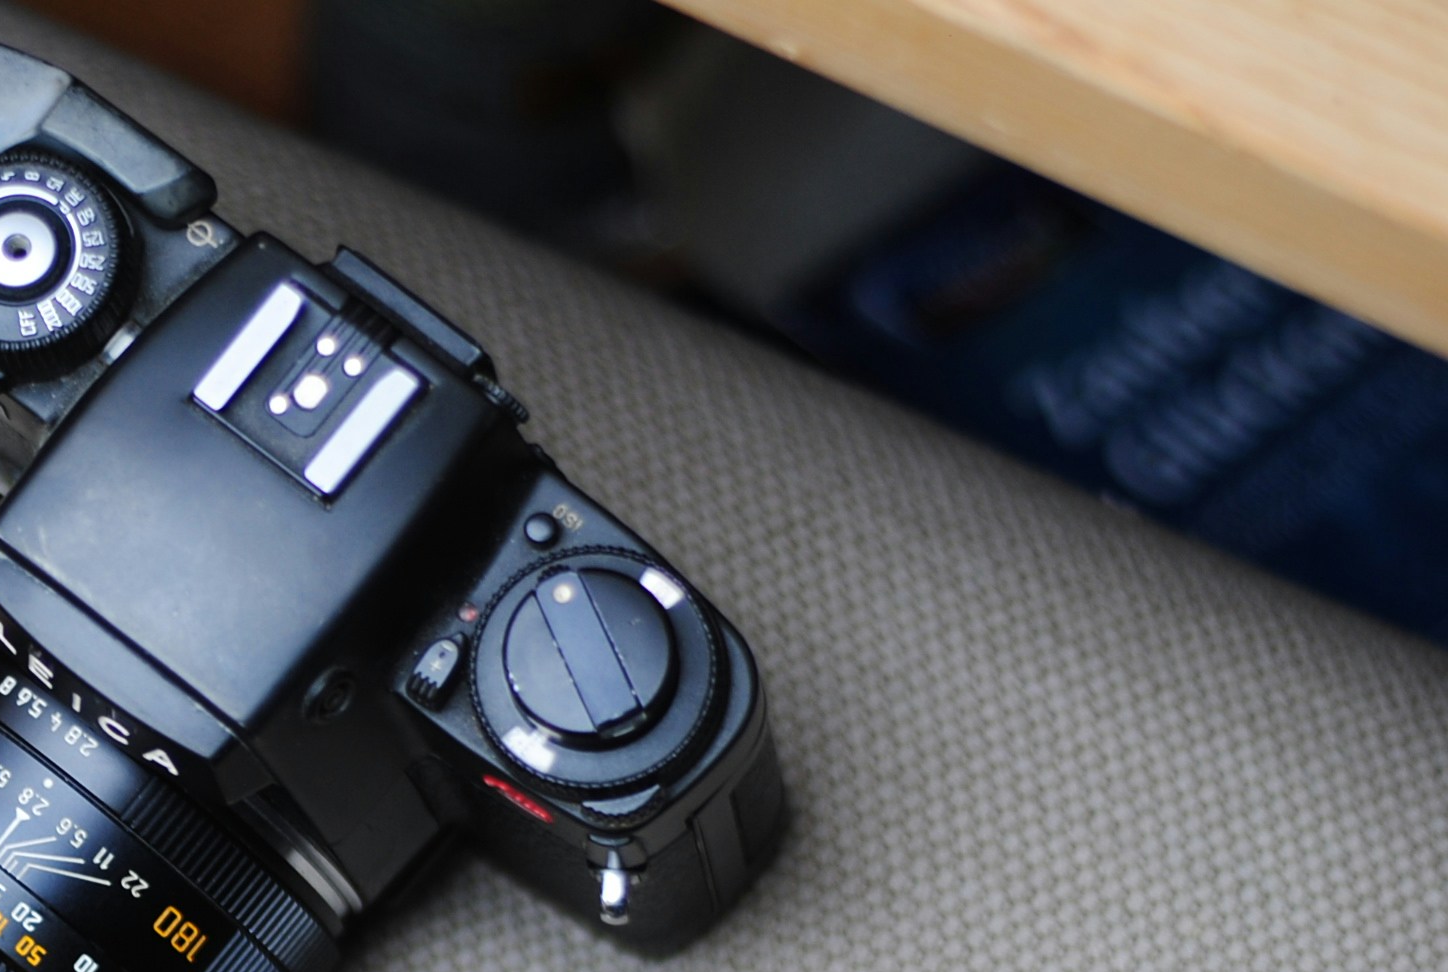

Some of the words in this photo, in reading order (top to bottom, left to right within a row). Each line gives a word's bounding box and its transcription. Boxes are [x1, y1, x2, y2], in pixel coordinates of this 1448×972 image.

[46, 176, 64, 192] 15
[64, 188, 85, 206] 30
[76, 208, 95, 226] 60
[82, 232, 104, 247] 125
[80, 253, 105, 270] 250
[70, 273, 97, 296] 500
[56, 288, 83, 316] 1000
[18, 310, 36, 336] OFF
[16, 687, 48, 719] 5.6
[51, 711, 62, 732] 4
[64, 725, 99, 757] 2.8
[18, 787, 50, 816] 2.8
[55, 817, 88, 849] 5.6
[93, 846, 115, 870] 11
[121, 869, 149, 898] 22
[11, 902, 44, 932] 20
[153, 905, 207, 963] 180
[15, 935, 47, 966] 50
